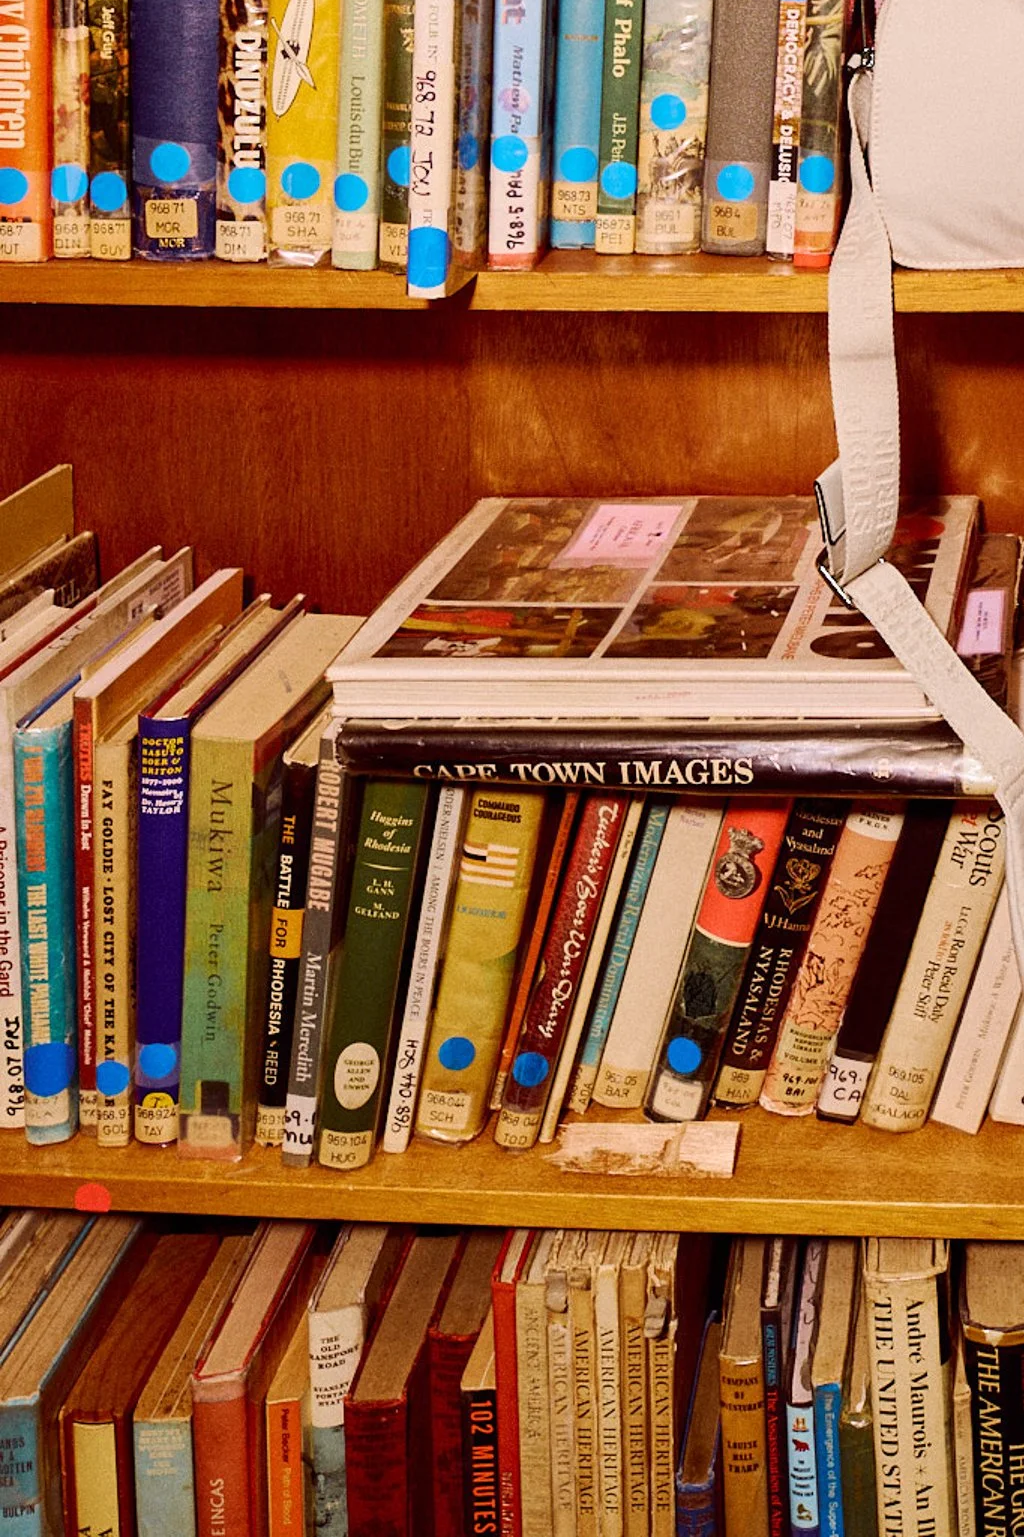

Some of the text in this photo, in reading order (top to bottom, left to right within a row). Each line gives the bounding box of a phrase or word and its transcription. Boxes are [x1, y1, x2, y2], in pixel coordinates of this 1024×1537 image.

[611, 18, 633, 79] Phalo
[101, 780, 112, 814] FAY
[369, 811, 413, 828] Huggins
[478, 799, 520, 812] COMMANDO
[101, 818, 113, 873] GOLDIE
[206, 779, 234, 894] Mukiwa
[364, 840, 411, 854] Rhodesia
[383, 830, 394, 840] of
[802, 828, 823, 839] and
[951, 830, 978, 870] War
[102, 886, 113, 925] LOST
[355, 908, 399, 919] GELFAND
[367, 886, 394, 897] GANN
[103, 929, 113, 967] CITY
[264, 814, 296, 1086] THE BATTLE FOR RHODESIA REED
[104, 972, 113, 993] OF
[733, 945, 773, 1056] NYASALAND
[750, 948, 792, 1062] RHODESIAS &
[104, 998, 113, 1030] THE
[294, 952, 323, 1081] Martin Meredith
[575, 1330, 594, 1515] AMERICAN HERITAGE
[601, 1330, 618, 1515] AMERICAN HERITAGE
[627, 1324, 644, 1512] AMERICAN HERITAGE
[905, 1297, 936, 1513] André Maurois An
[977, 1347, 1006, 1507] THE AMERICAN
[470, 1399, 496, 1534] 102 MINUTES
[210, 1478, 224, 1526] INCAS
